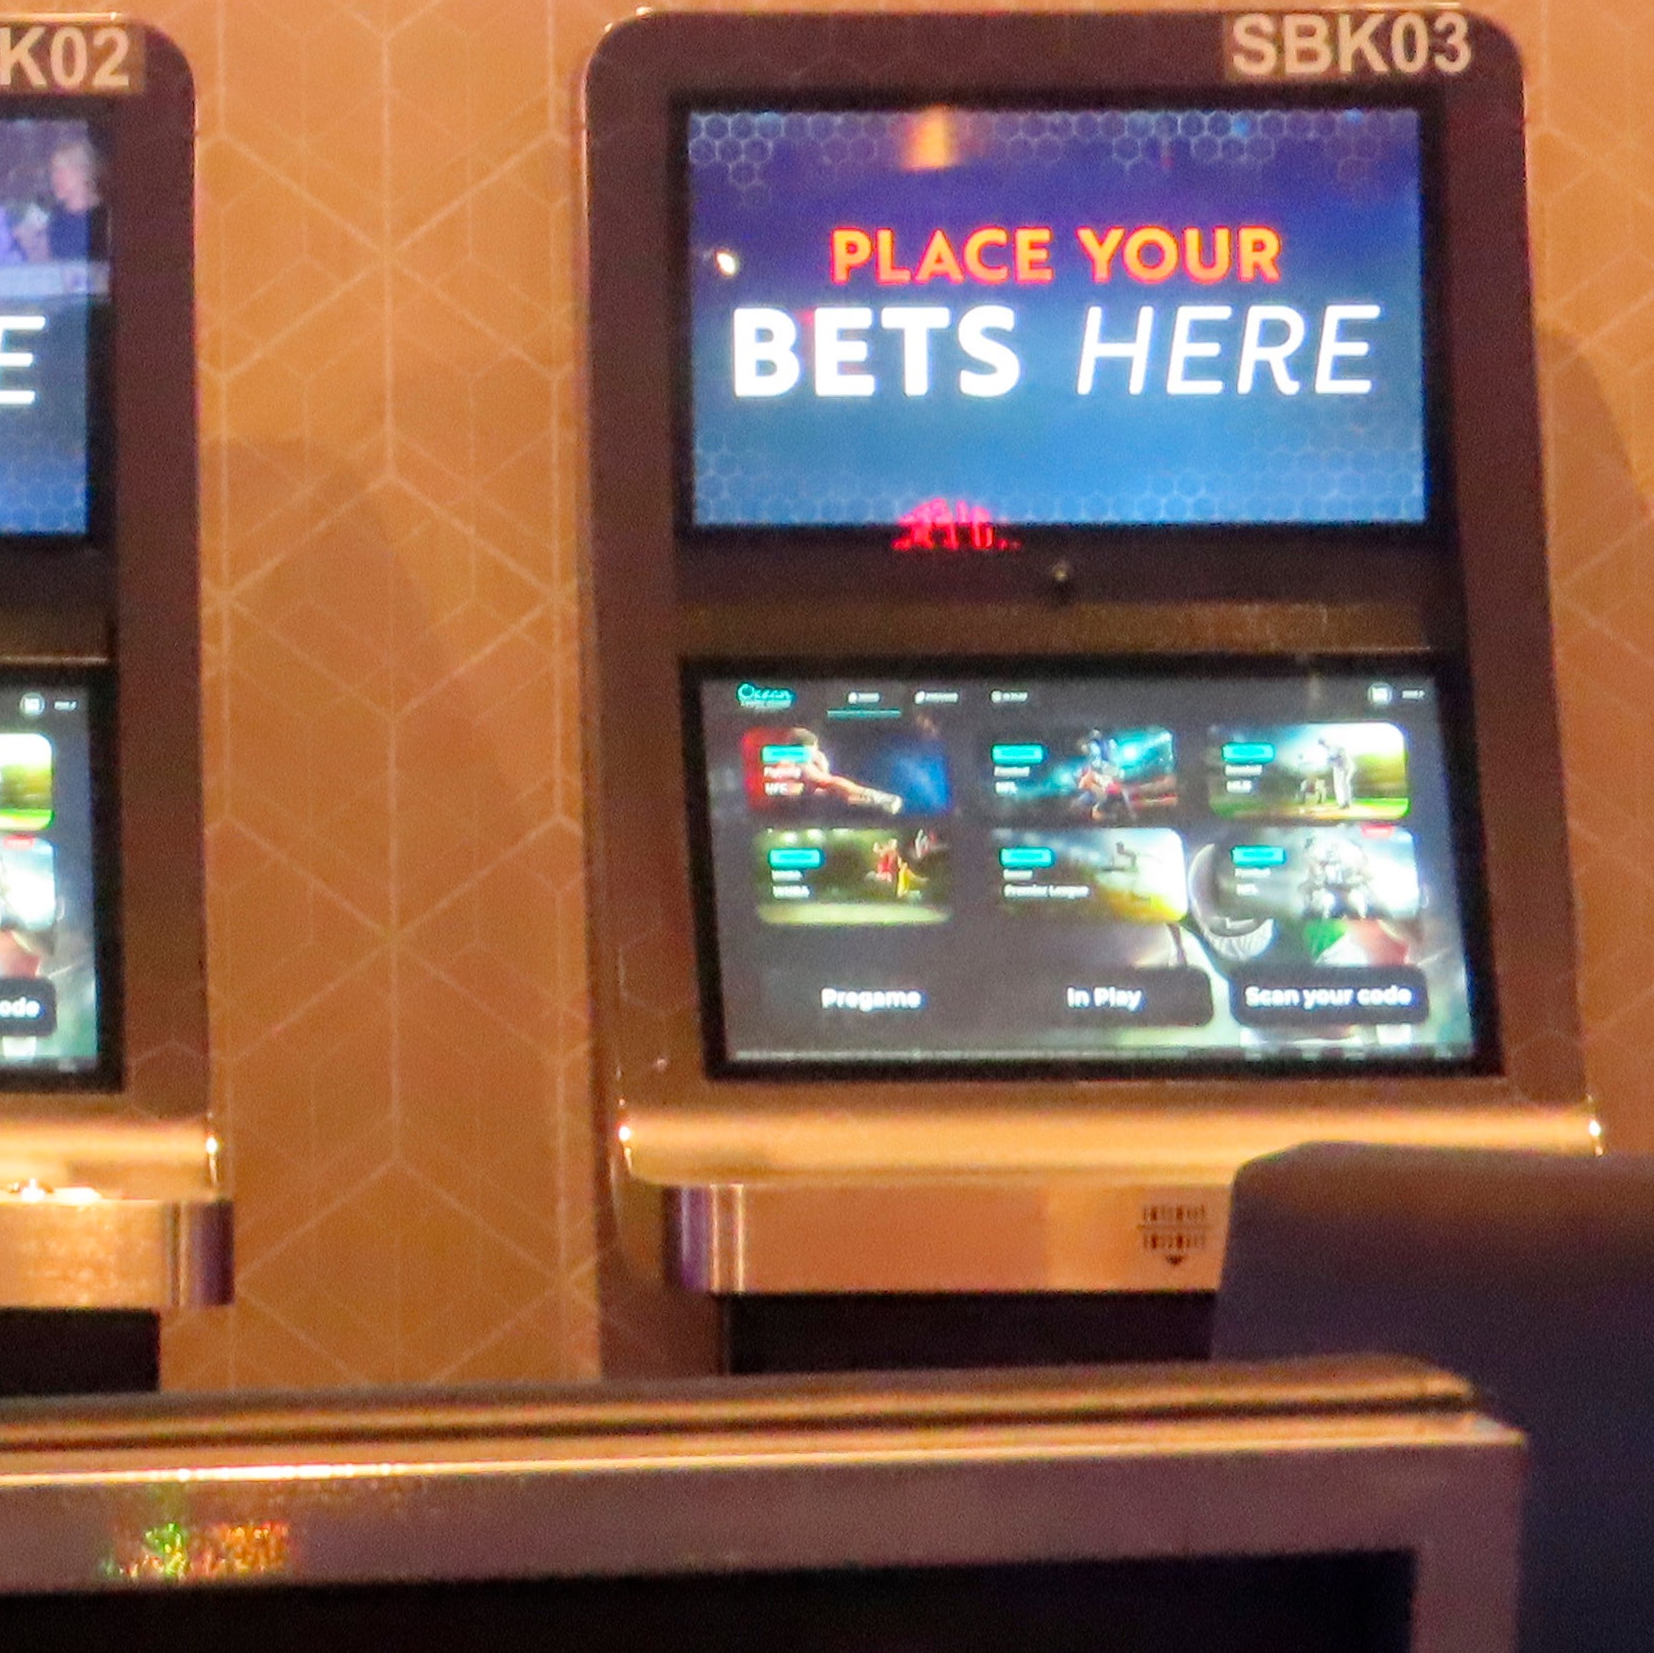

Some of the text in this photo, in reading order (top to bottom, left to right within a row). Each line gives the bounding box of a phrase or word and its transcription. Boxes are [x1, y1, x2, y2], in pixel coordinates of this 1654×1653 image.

[1231, 13, 1474, 77] SBK03
[830, 226, 1283, 285] PLACE YOUR
[730, 303, 1381, 398] BETS HERE
[820, 987, 923, 1013] Pregame
[1067, 986, 1143, 1011] In Play
[1244, 985, 1413, 1011] Scan your code
